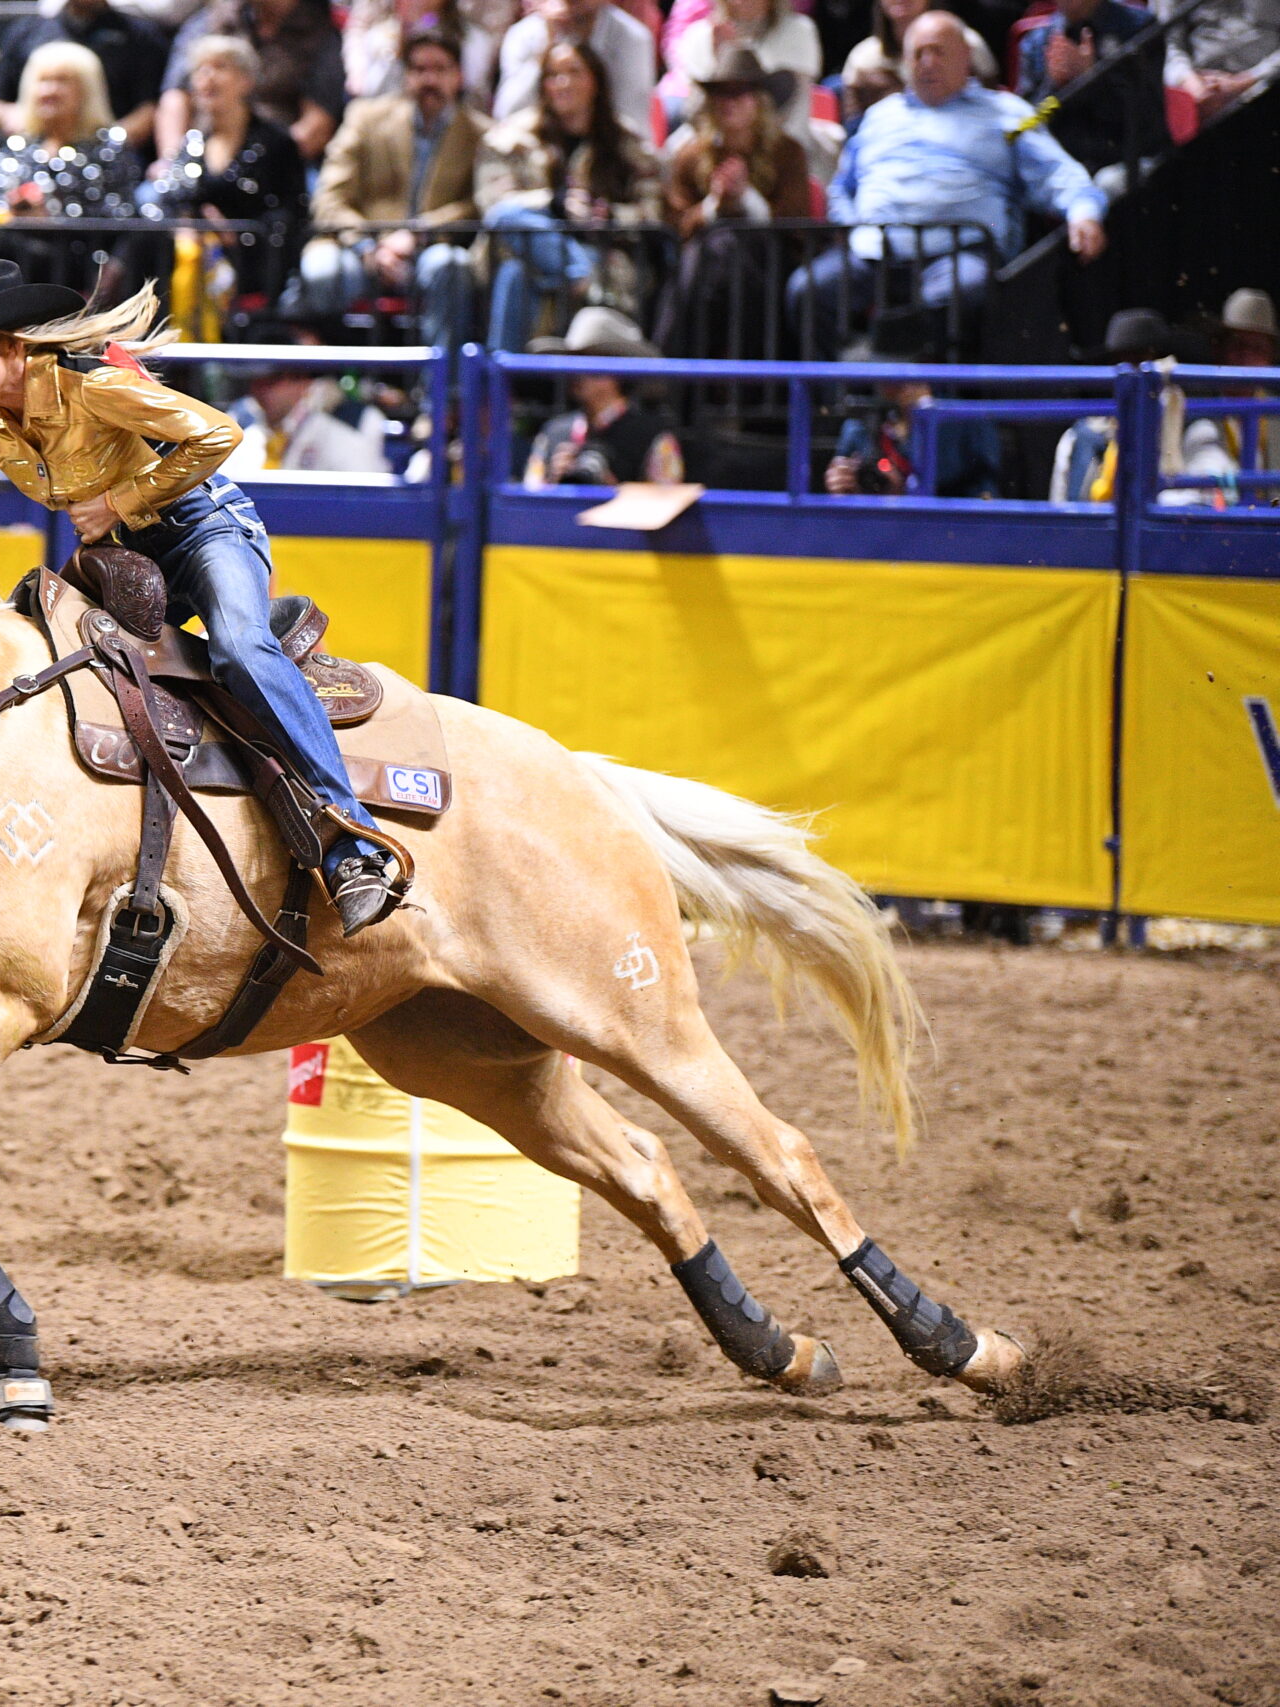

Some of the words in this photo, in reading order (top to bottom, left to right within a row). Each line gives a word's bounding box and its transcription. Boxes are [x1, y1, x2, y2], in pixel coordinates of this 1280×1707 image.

[393, 769, 438, 798] CSI
[396, 792, 416, 801] ELITE
[420, 795, 438, 806] TEAM
